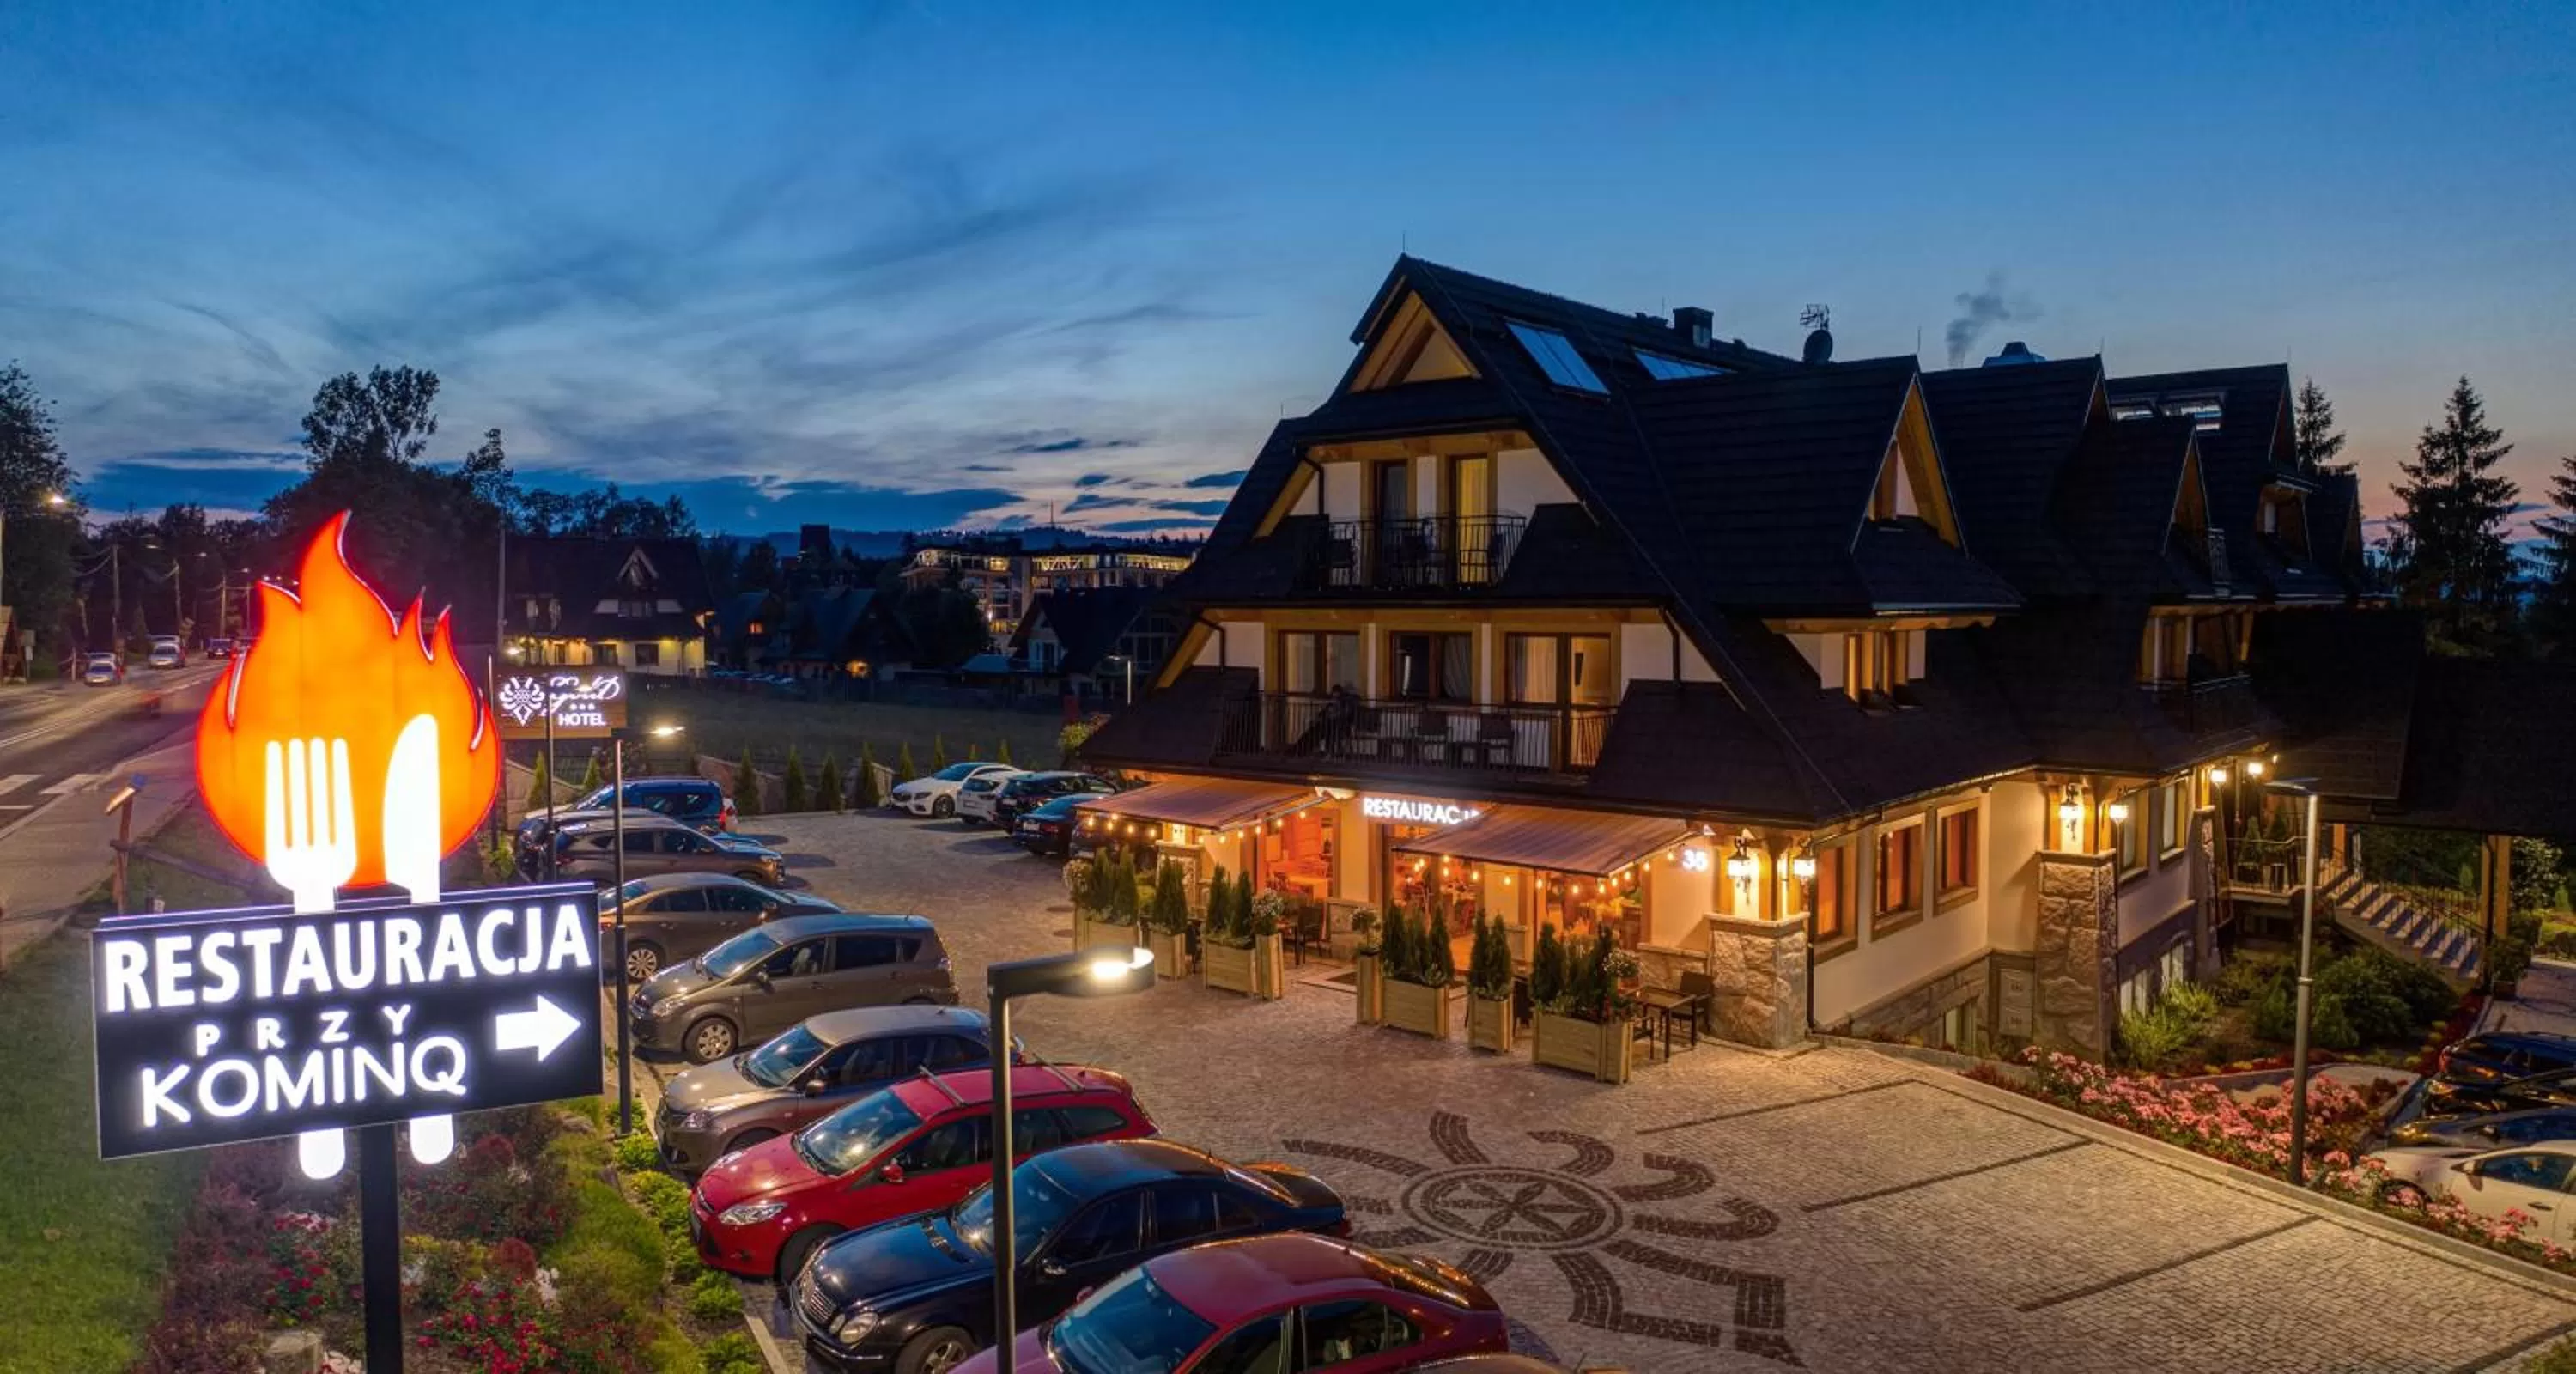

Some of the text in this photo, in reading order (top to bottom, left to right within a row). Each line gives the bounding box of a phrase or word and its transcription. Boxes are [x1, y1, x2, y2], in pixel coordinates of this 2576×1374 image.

[558, 713, 606, 727] HOTEL
[103, 903, 592, 1014] RESTAURACJA
[195, 1004, 412, 1057] PRZY
[140, 1036, 468, 1128] KOMINQ
